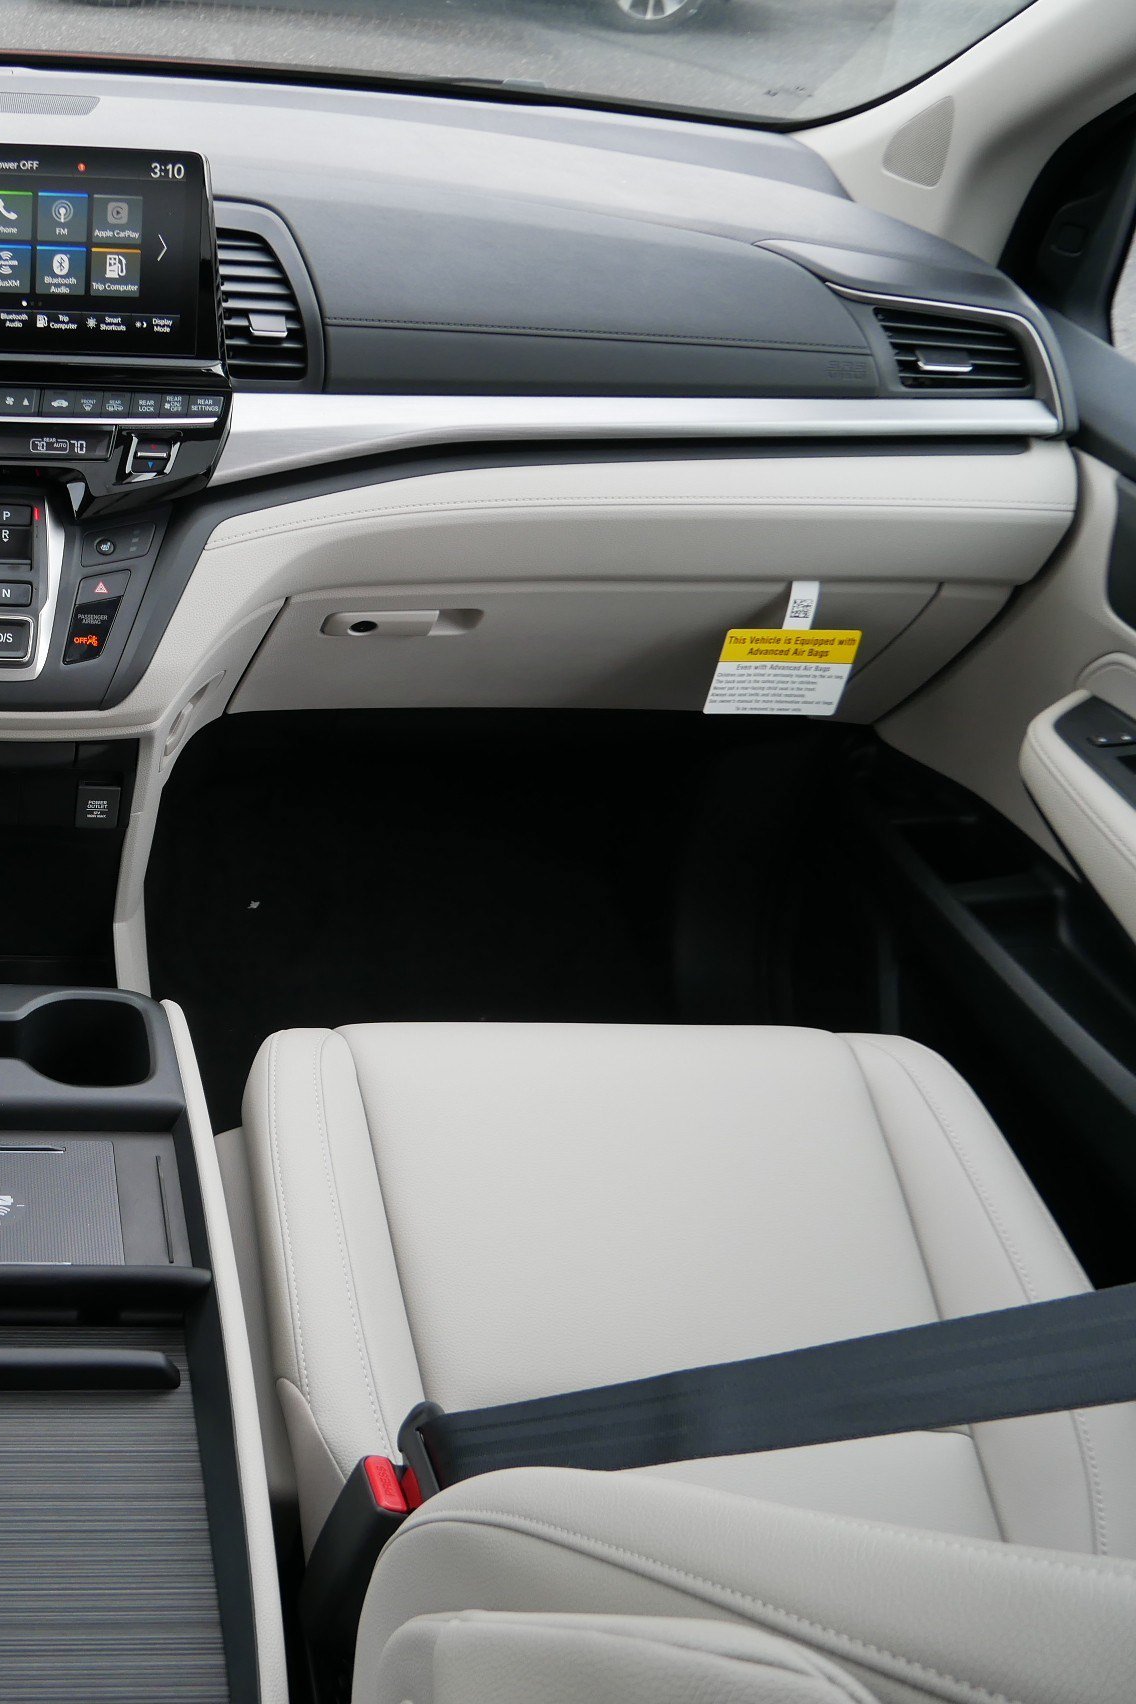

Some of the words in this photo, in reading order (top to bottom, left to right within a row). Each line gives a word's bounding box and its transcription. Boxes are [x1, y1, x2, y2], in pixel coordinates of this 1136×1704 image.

[19, 160, 40, 170] OFF
[150, 162, 185, 179] 3:10
[55, 227, 68, 235] FM
[94, 229, 114, 238] Apple
[114, 230, 140, 239] CarPlay
[44, 276, 77, 285] Bluetooth
[50, 285, 70, 294] Audio
[92, 282, 105, 291] Trip
[105, 283, 139, 292] Computer
[0, 313, 29, 321] Bluetooth
[58, 314, 70, 323] Trip
[104, 316, 122, 324] Smart
[5, 320, 23, 328] Audio
[50, 322, 78, 330] Computer
[152, 318, 173, 326] Display
[100, 324, 127, 332] Shortcuts
[153, 325, 171, 333] Mode
[138, 399, 155, 407] REAR
[191, 404, 219, 412] SETTINGS
[34, 441, 47, 451] 70
[70, 440, 86, 454] 70
[2, 511, 11, 521] P
[2, 529, 10, 539] R
[2, 588, 11, 598] N
[77, 613, 108, 621] PASSENGER
[73, 636, 88, 644] OFF
[728, 635, 747, 645] This
[750, 636, 781, 645] Vehicle
[784, 636, 792, 645] is
[795, 636, 835, 647] Equipped
[838, 637, 856, 646] with
[746, 648, 790, 656] Advanced
[792, 648, 806, 657] Air
[807, 649, 830, 658] Bags
[736, 663, 752, 671] Even
[803, 664, 814, 672] Air
